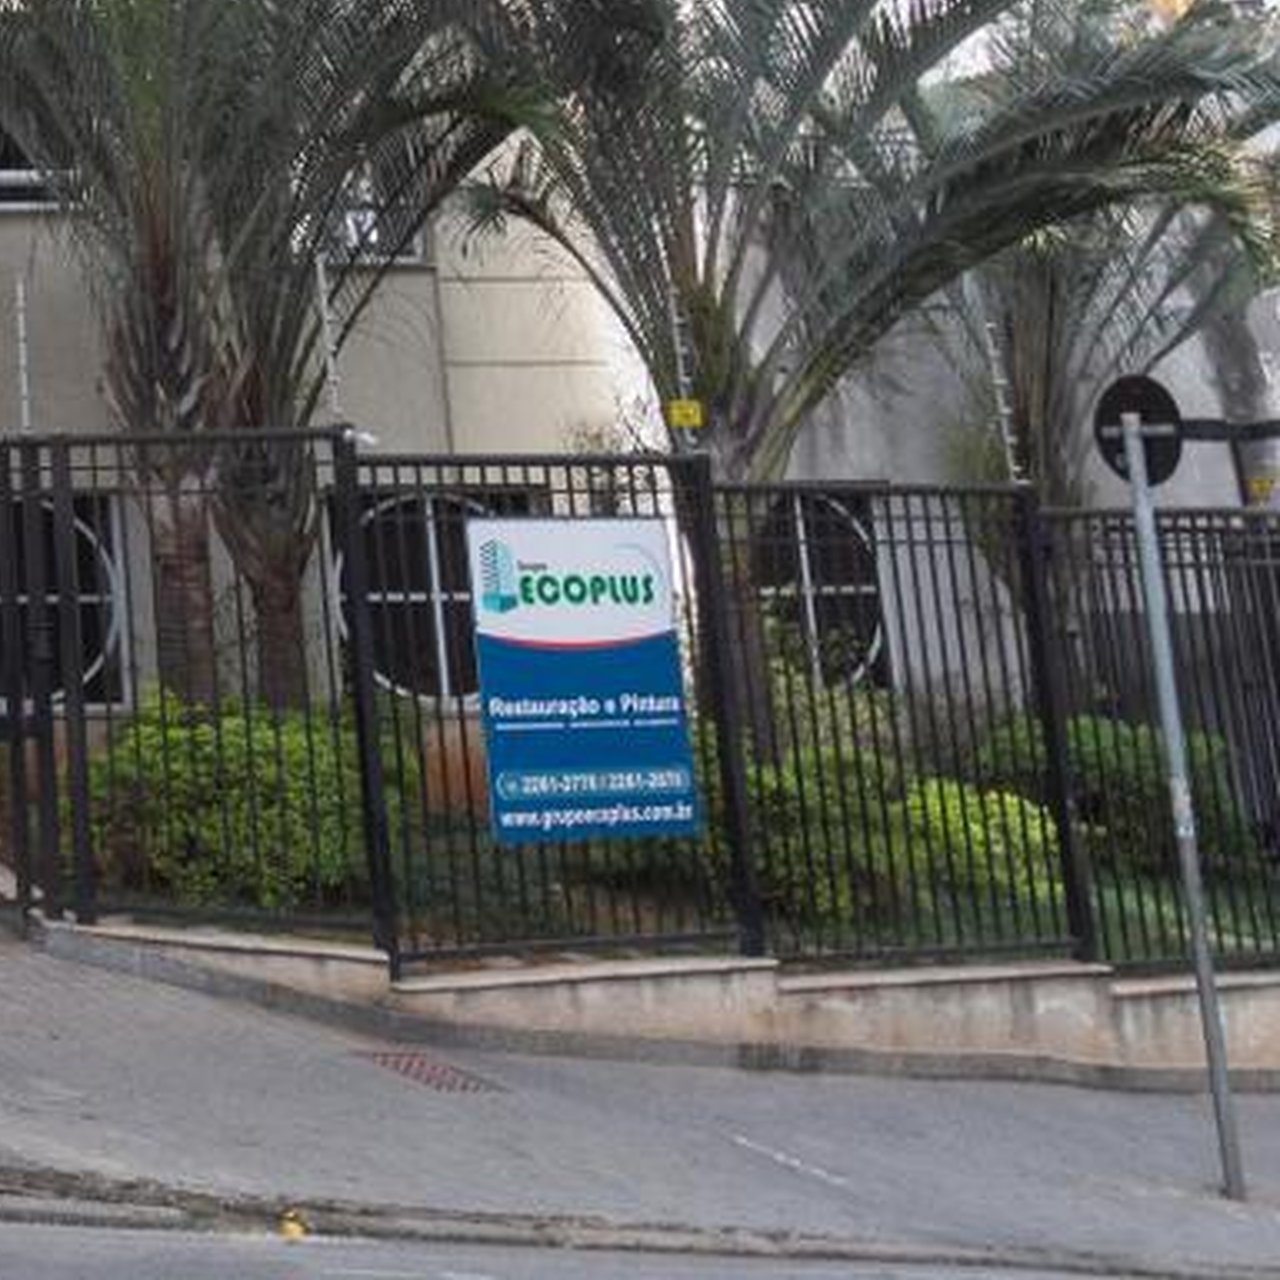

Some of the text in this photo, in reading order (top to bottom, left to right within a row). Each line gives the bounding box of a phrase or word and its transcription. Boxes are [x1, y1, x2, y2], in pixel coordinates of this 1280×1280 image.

[519, 574, 654, 605] ECOPLUS
[490, 692, 680, 718] Restauração e Pintura
